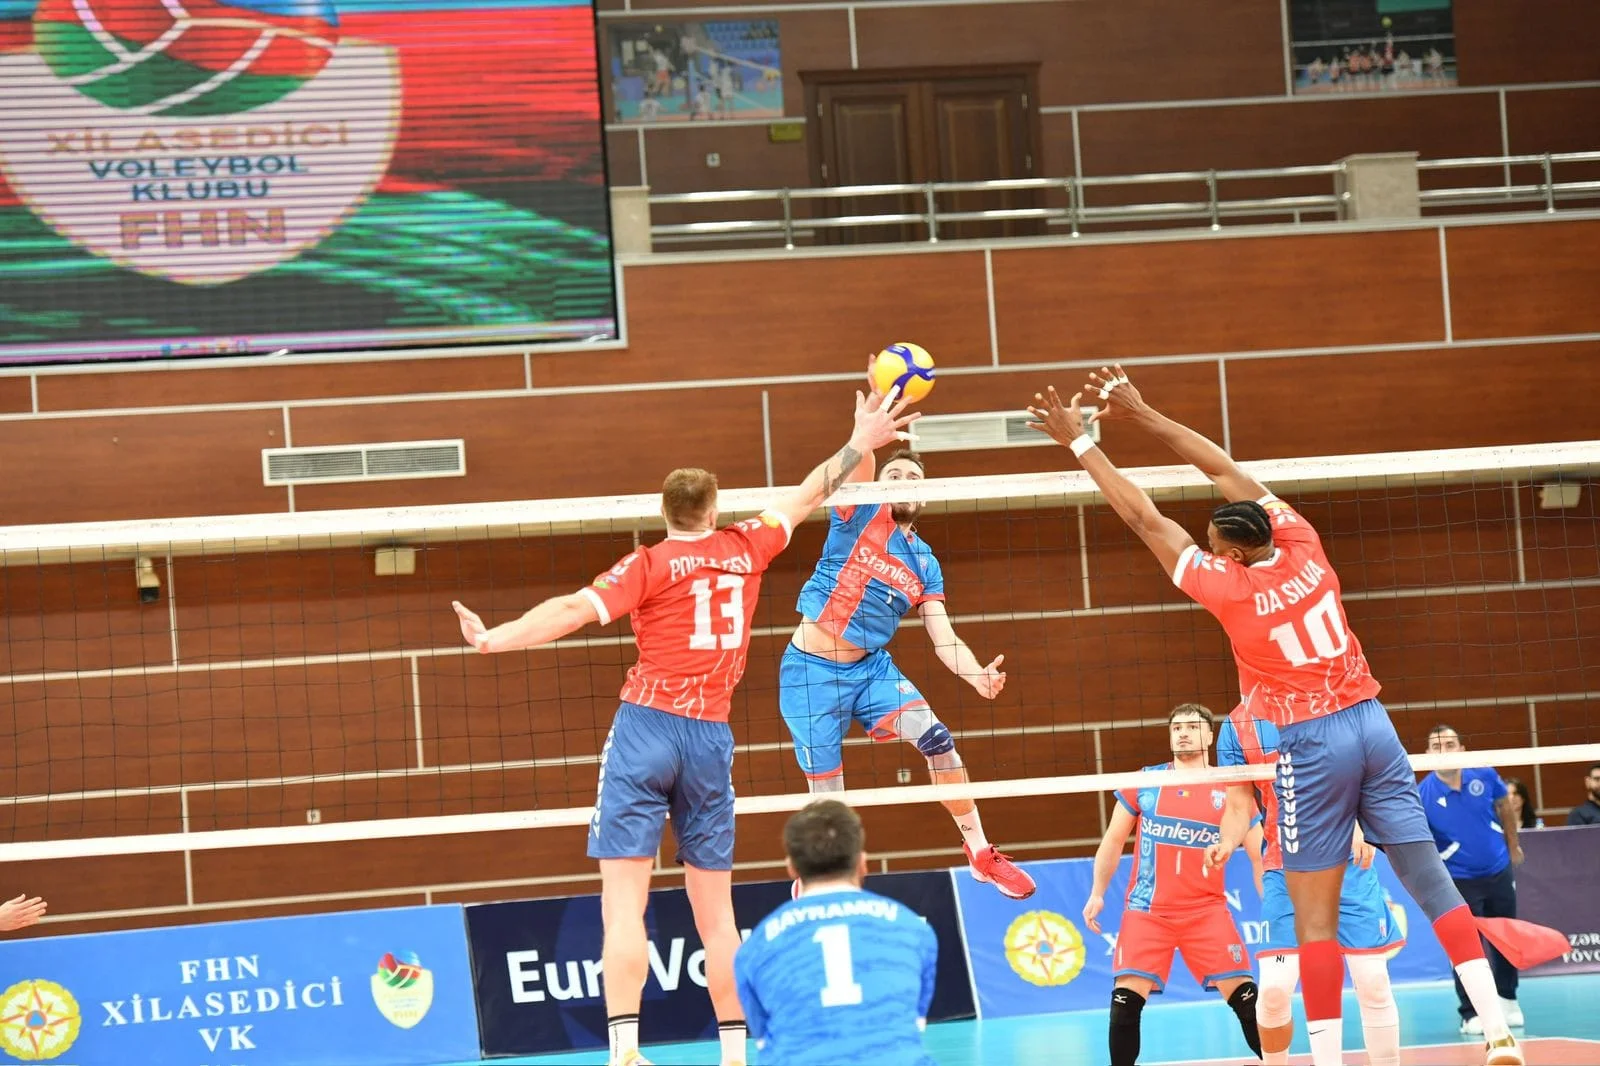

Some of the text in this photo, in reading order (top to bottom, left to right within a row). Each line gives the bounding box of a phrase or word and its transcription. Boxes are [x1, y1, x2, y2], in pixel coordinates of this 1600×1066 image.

[89, 154, 309, 180] VOLEYBOL
[132, 178, 271, 201] KLUBU
[119, 207, 287, 249] FHN
[1254, 559, 1326, 616] DA SILVA
[688, 574, 745, 650] 13
[1269, 590, 1348, 667] 10
[1141, 816, 1220, 844] Stanleybe
[180, 954, 260, 984] FHN
[812, 924, 862, 1007] 1
[102, 975, 344, 1027] XİLASEDİCİ
[198, 1025, 257, 1052] VK
